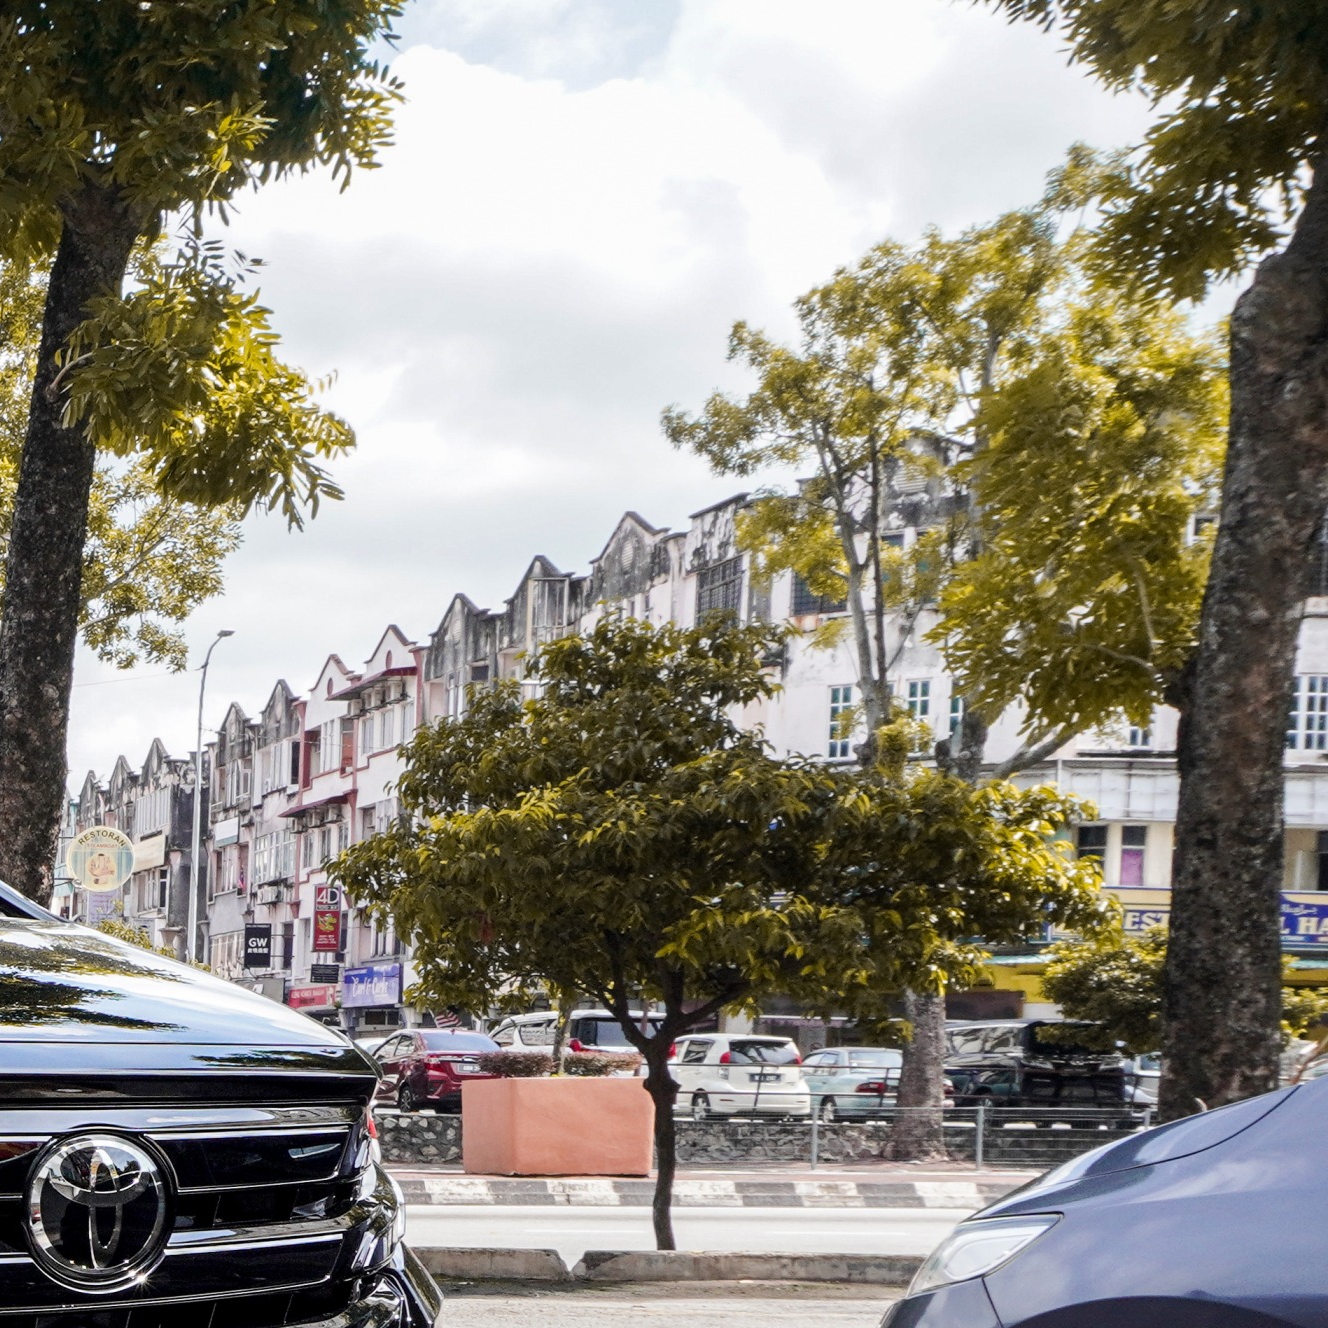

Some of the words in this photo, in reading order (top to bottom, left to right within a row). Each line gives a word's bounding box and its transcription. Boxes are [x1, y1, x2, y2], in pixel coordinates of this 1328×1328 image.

[78, 830, 126, 847] RESTORAN
[316, 888, 339, 904] 4D
[248, 937, 268, 948] GW
